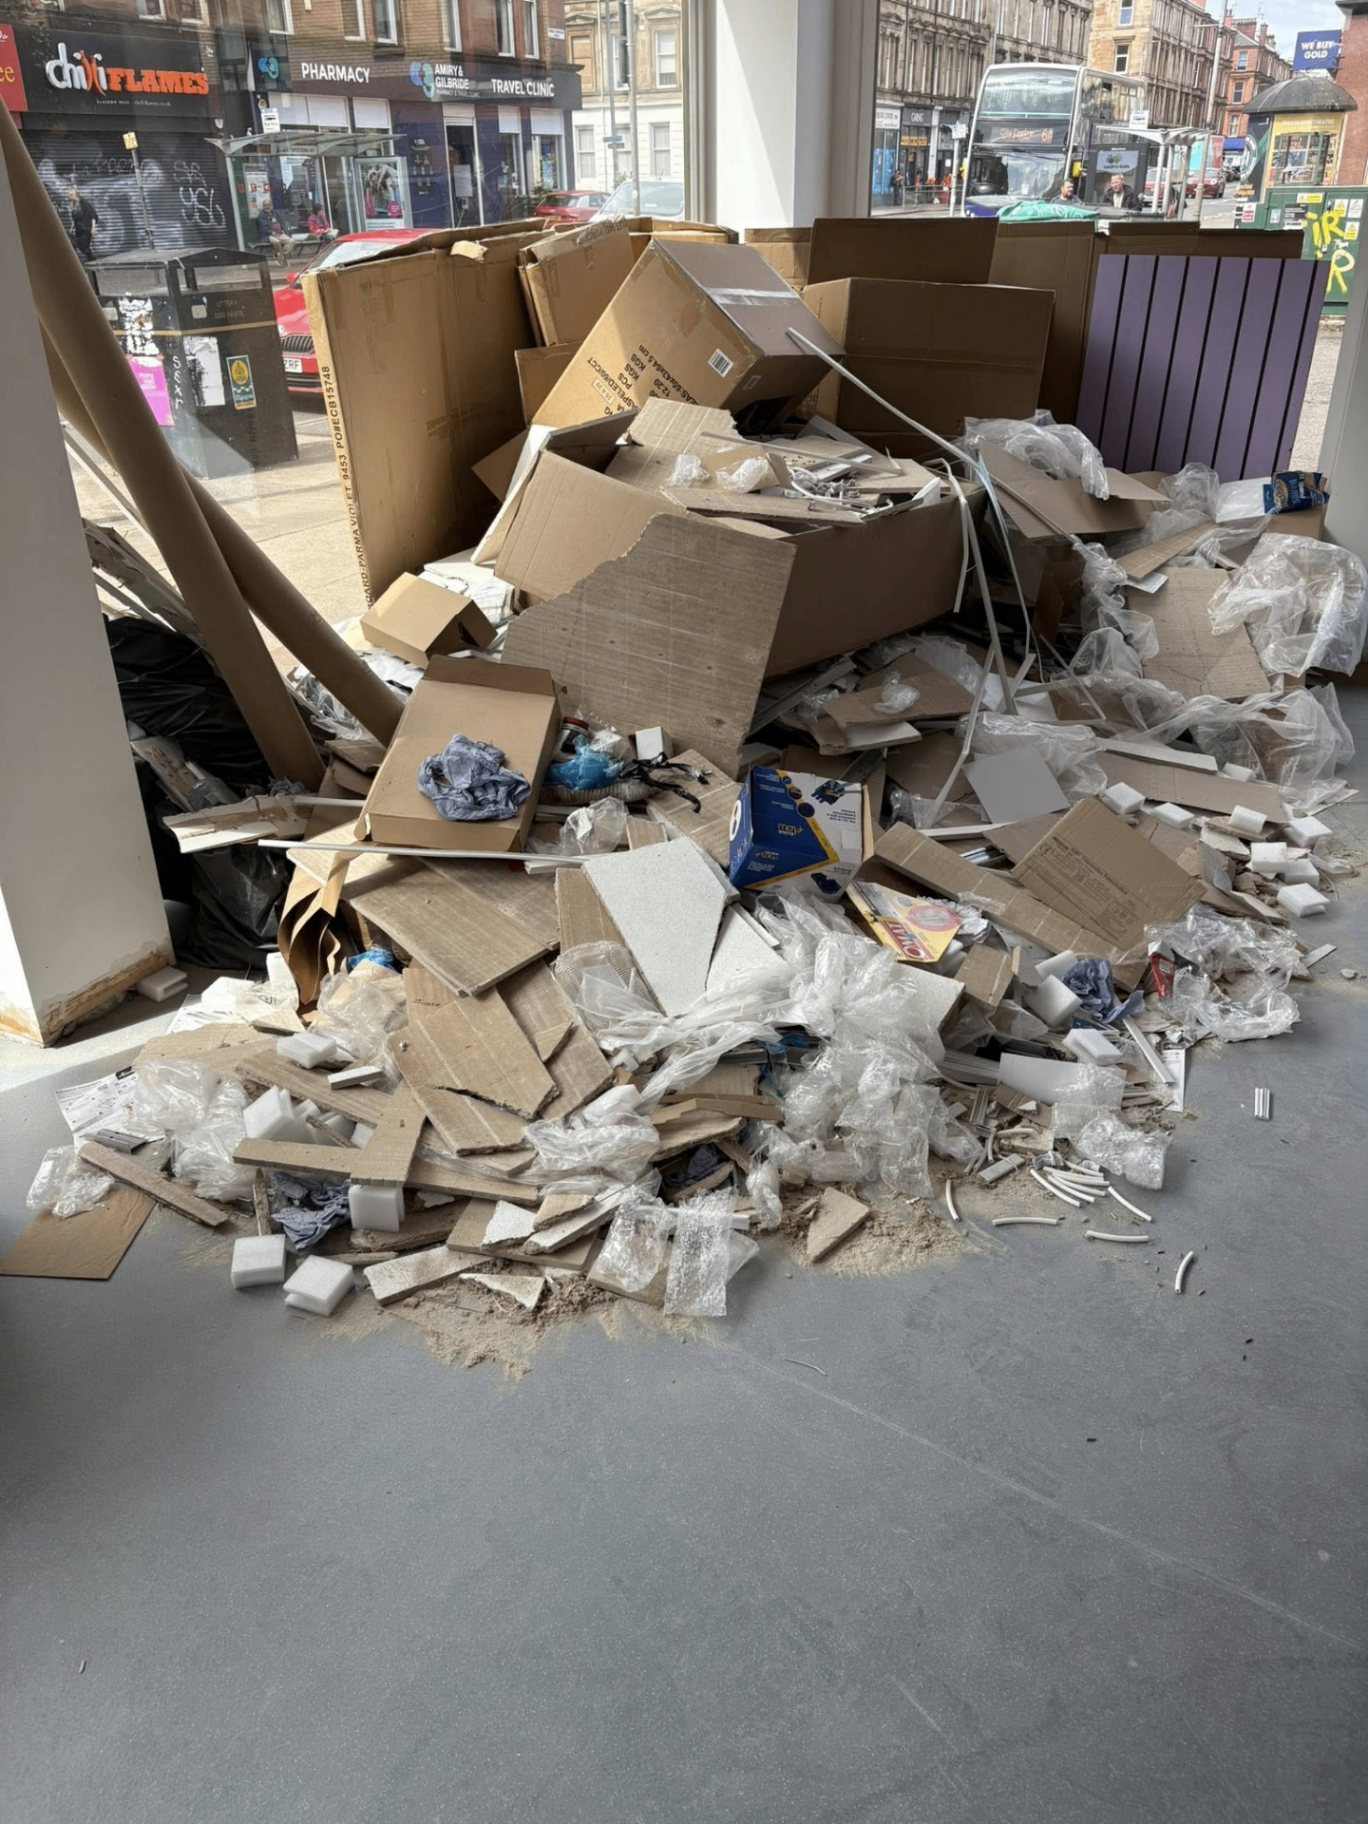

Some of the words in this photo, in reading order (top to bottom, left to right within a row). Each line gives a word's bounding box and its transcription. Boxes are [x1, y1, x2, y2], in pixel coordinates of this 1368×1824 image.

[1301, 42, 1316, 50] WE
[1316, 40, 1334, 49] BUY
[1304, 50, 1328, 59] GOLD
[301, 62, 370, 84] PHARMACY
[434, 63, 458, 77] AMIRY
[106, 68, 209, 95] FLAMES
[435, 76, 470, 90] GILBRIDE
[491, 78, 525, 95] TRAVEL
[526, 81, 555, 97] CLINIC
[638, 345, 650, 357] cm
[631, 353, 647, 371] KGS
[617, 372, 633, 390] PCS
[624, 363, 640, 381] KGS
[654, 378, 671, 397] 12.20
[321, 366, 345, 449] PO#ECB15748
[338, 454, 350, 481] 9453
